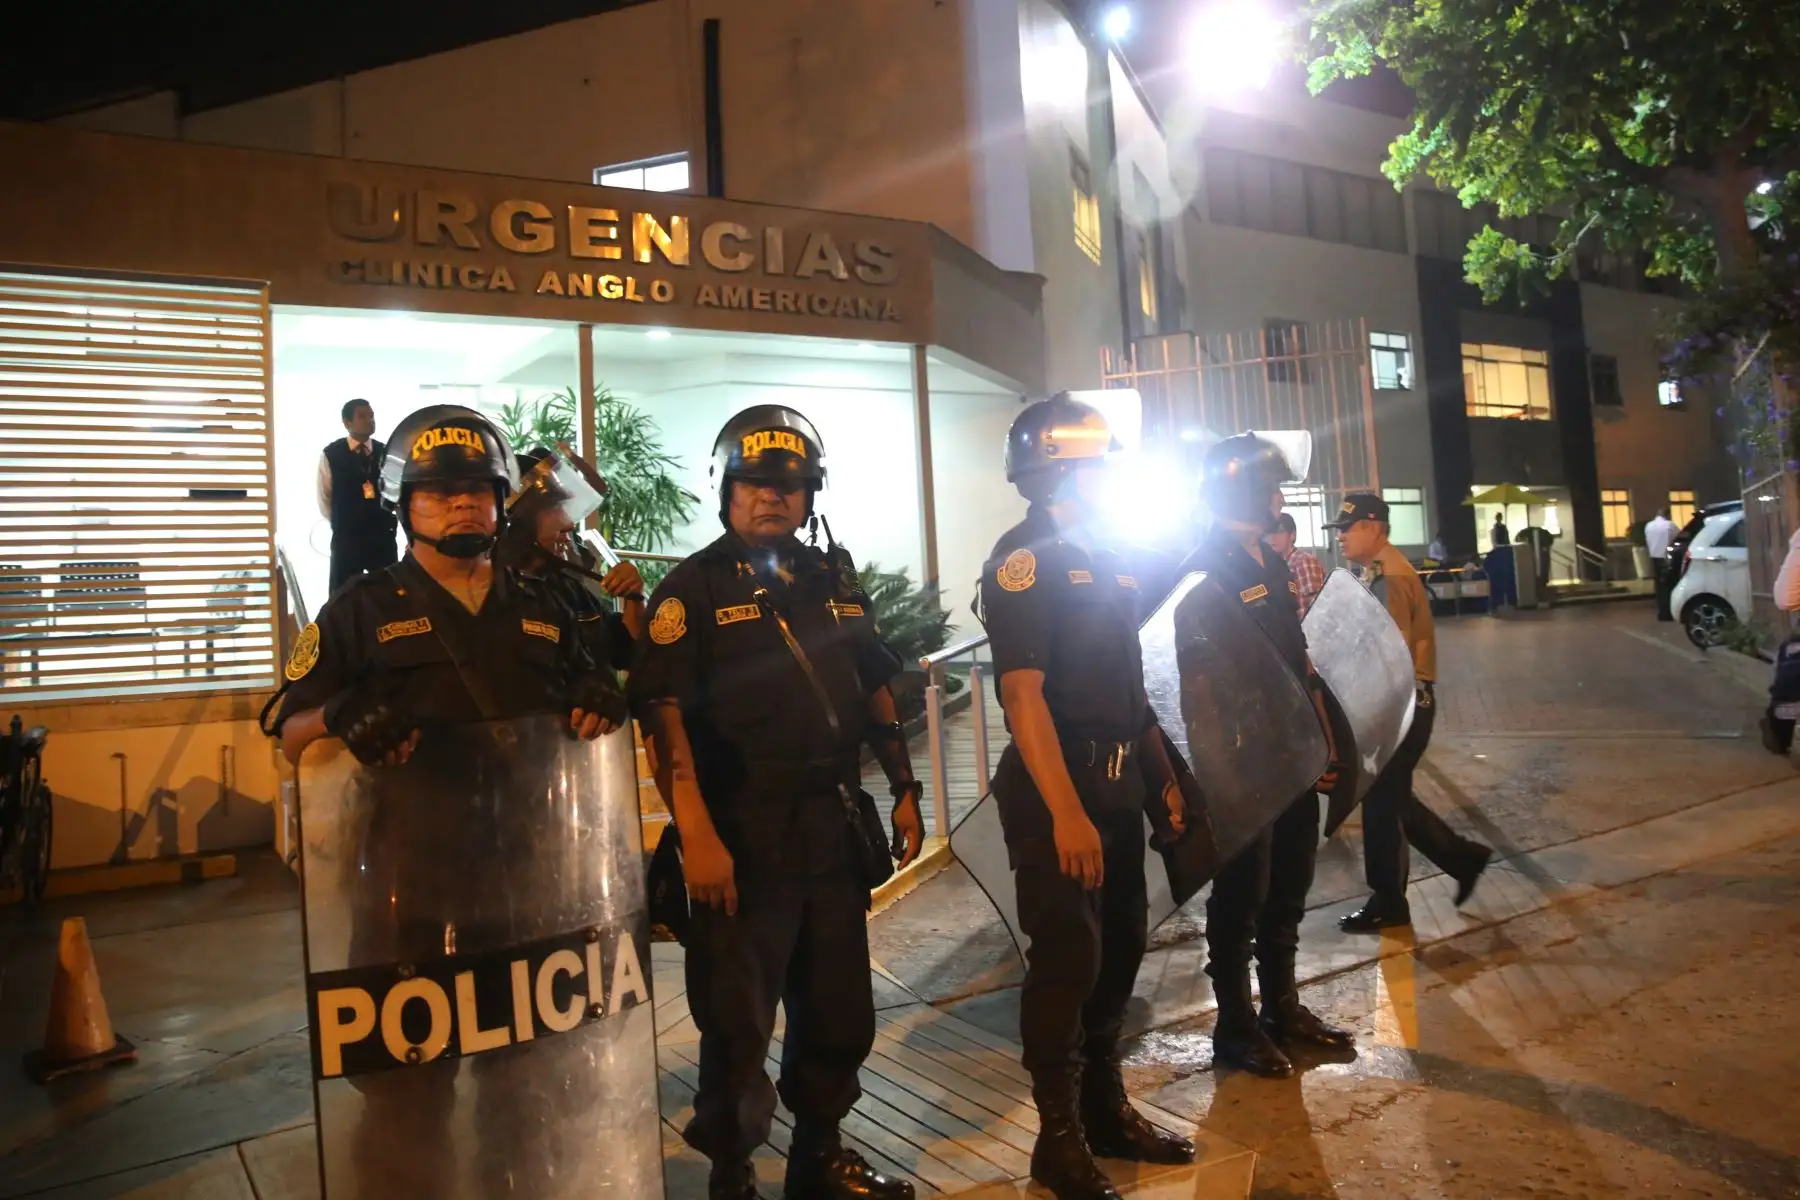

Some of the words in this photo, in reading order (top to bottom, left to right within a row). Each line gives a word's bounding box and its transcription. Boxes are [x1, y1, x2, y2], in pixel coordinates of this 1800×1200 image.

[326, 182, 900, 286] URGENCIAS
[329, 257, 516, 293] CLINICA
[535, 270, 674, 303] ANGLO
[695, 284, 901, 323] AMERICANA
[412, 426, 486, 460] POLICIA
[742, 430, 807, 459] POLICIA
[317, 932, 649, 1078] POLICIA
